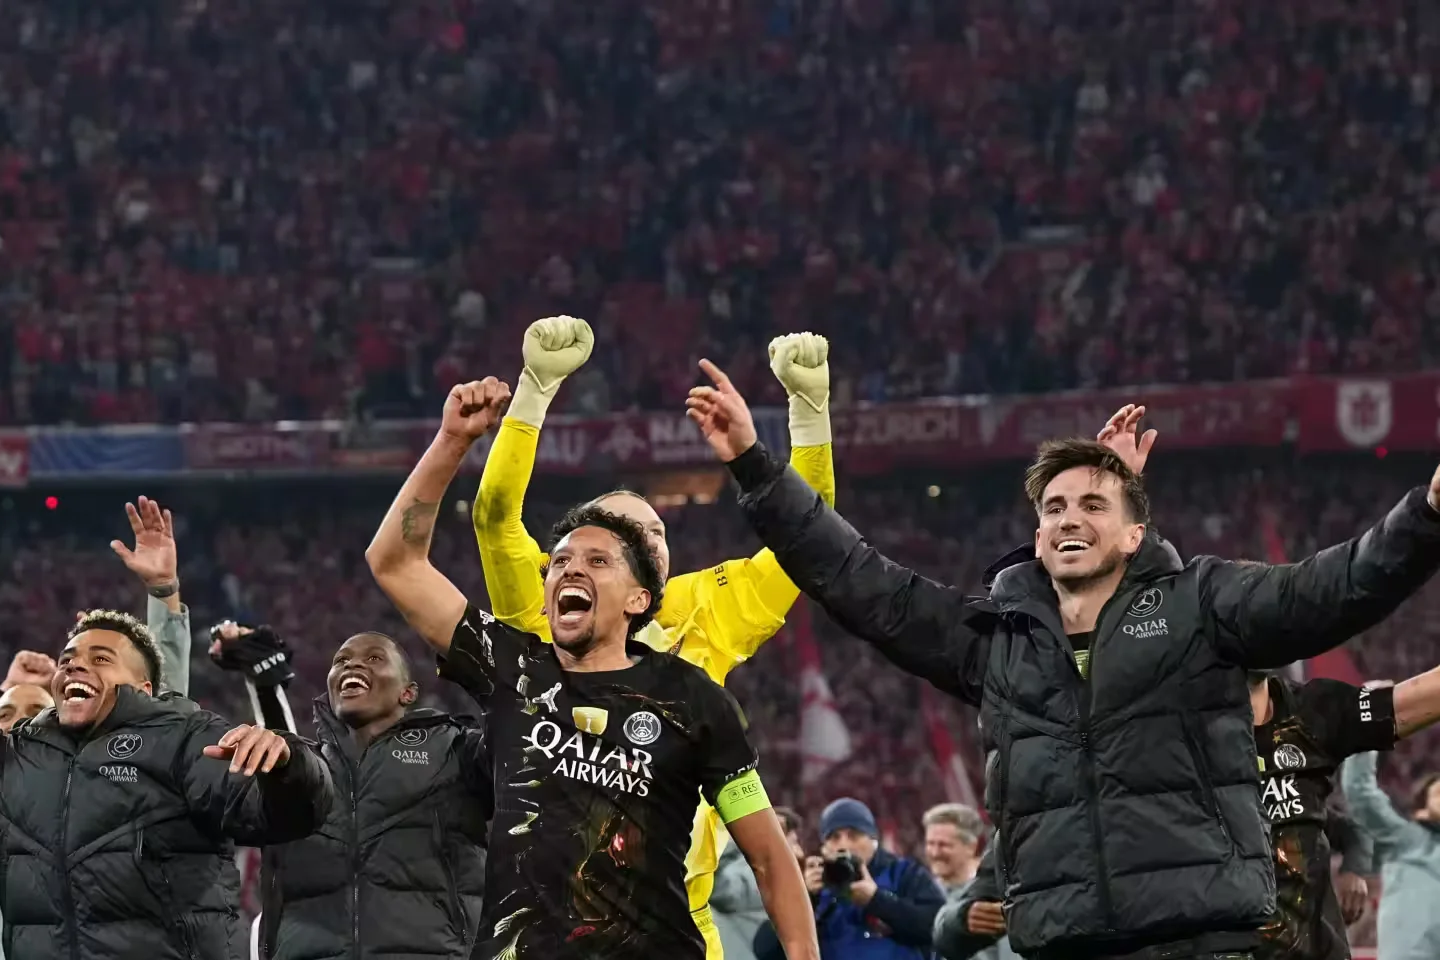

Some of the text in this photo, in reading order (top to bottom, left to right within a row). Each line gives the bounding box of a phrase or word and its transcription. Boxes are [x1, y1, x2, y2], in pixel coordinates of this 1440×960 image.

[1122, 618, 1168, 636] QATAR
[1135, 627, 1169, 639] AIRWAYS
[392, 749, 429, 760] QATAR
[531, 720, 654, 780] QATAR
[401, 758, 429, 766] AIRWAYS
[98, 765, 138, 777] QATAR
[109, 775, 138, 783] AIRWAYS
[552, 757, 651, 798] AIRWAYS
